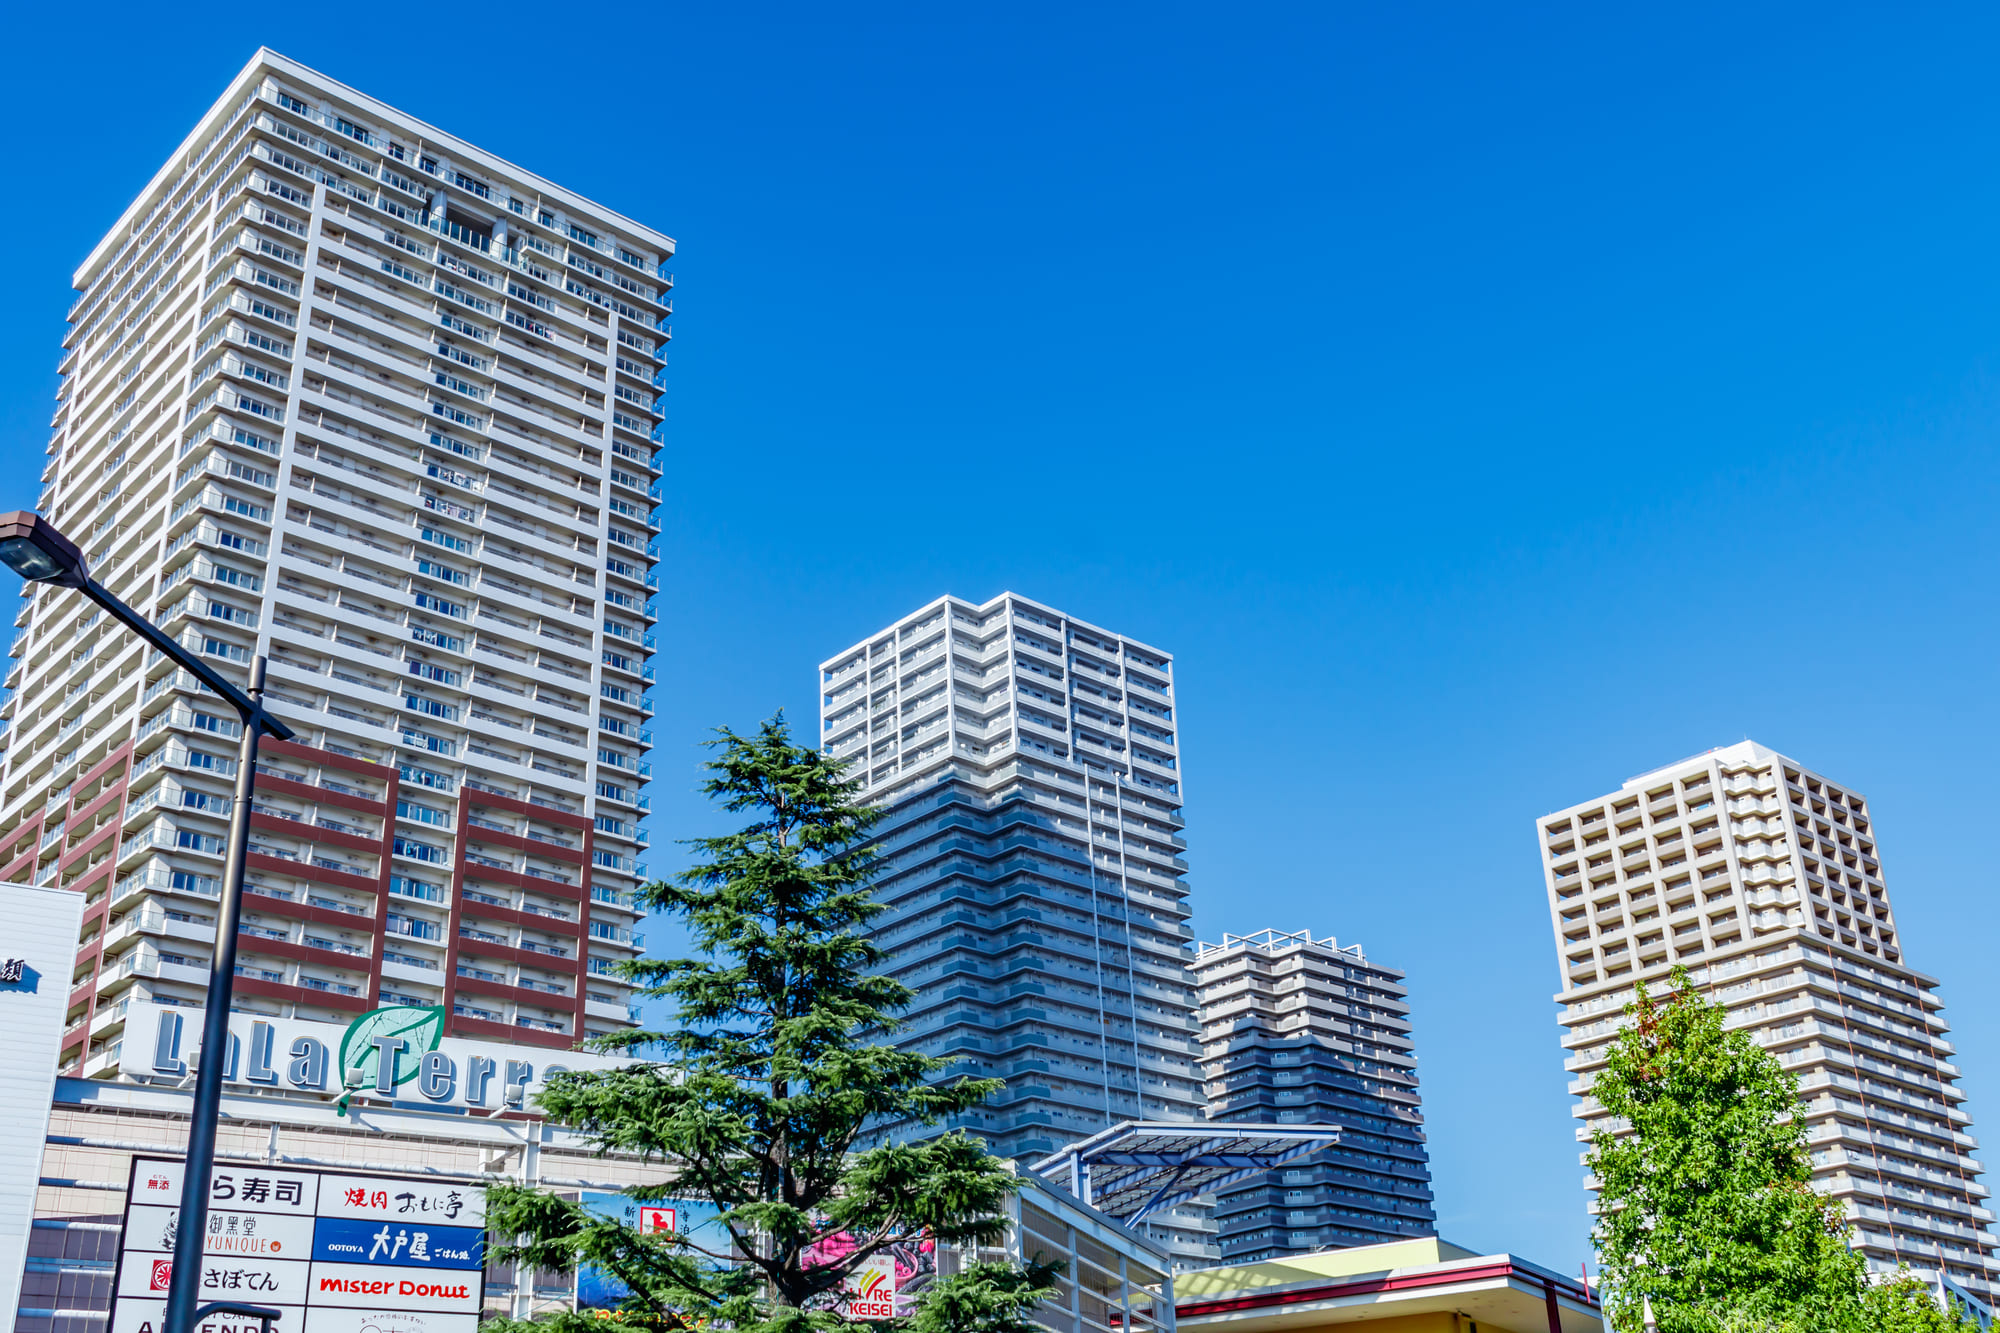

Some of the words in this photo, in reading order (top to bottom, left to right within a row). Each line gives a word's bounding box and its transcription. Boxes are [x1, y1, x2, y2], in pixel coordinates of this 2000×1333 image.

[152, 1009, 325, 1086] LLa
[344, 1187, 387, 1210] 焼肉
[206, 1235, 267, 1254] YUNIQUE
[327, 1243, 364, 1253] OOTOYA
[368, 1224, 431, 1262] 大戸屋
[203, 1268, 279, 1292] さぼてん
[398, 1280, 470, 1299] Donut
[849, 1302, 893, 1317] KEISEI
